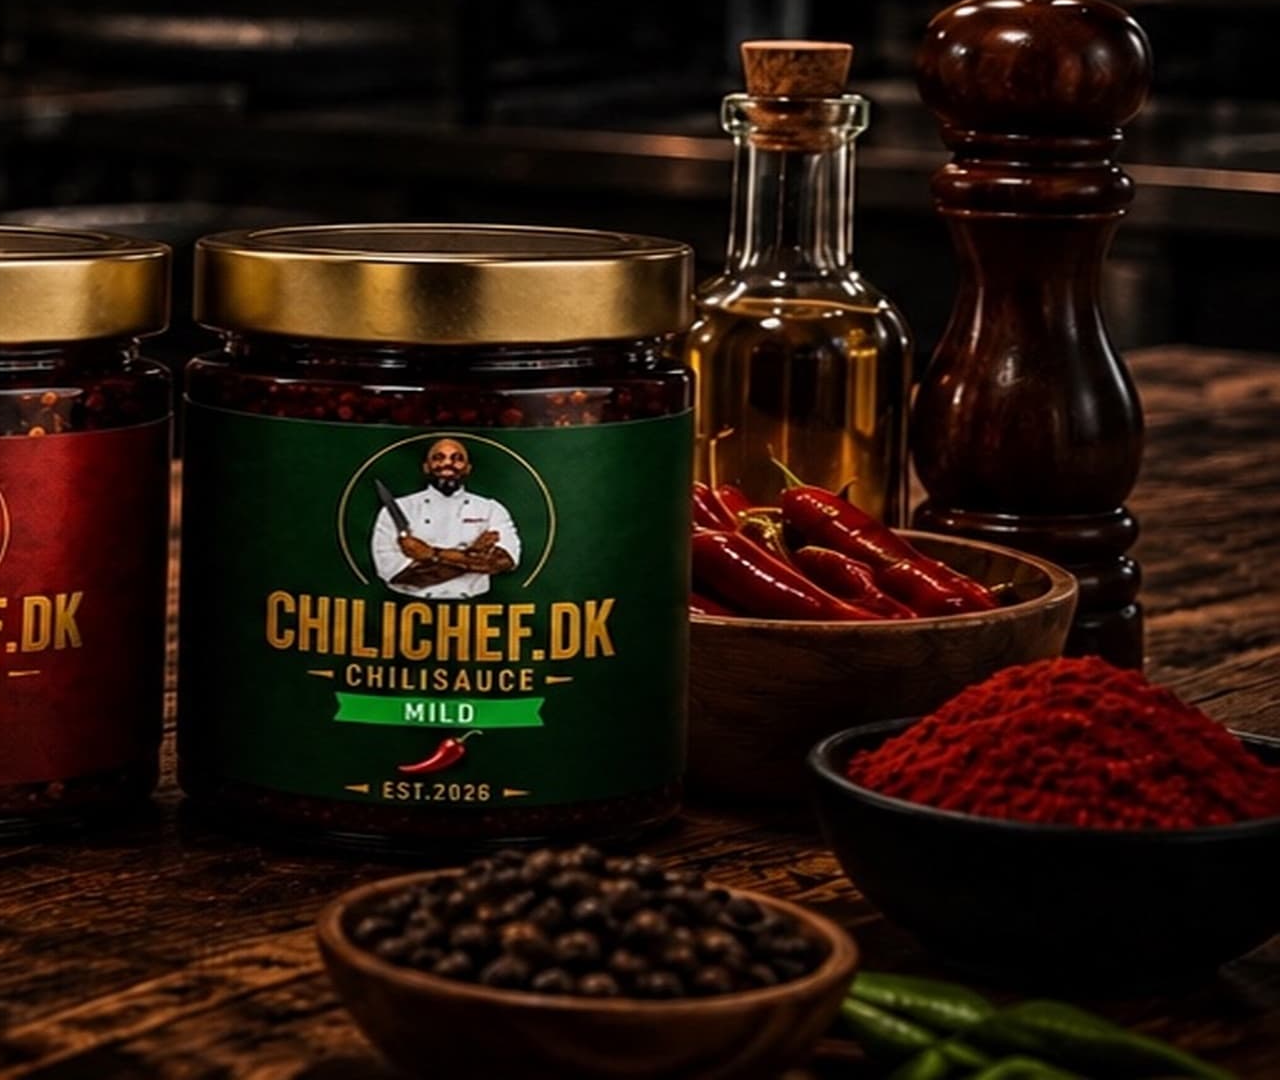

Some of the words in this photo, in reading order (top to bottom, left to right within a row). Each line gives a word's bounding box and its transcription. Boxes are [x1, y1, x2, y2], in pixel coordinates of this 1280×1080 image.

[265, 590, 617, 662] CHILICHEF.DK
[345, 663, 535, 692] CHILISAUCE
[404, 702, 475, 724] MILD
[382, 781, 491, 801] EST.2026
